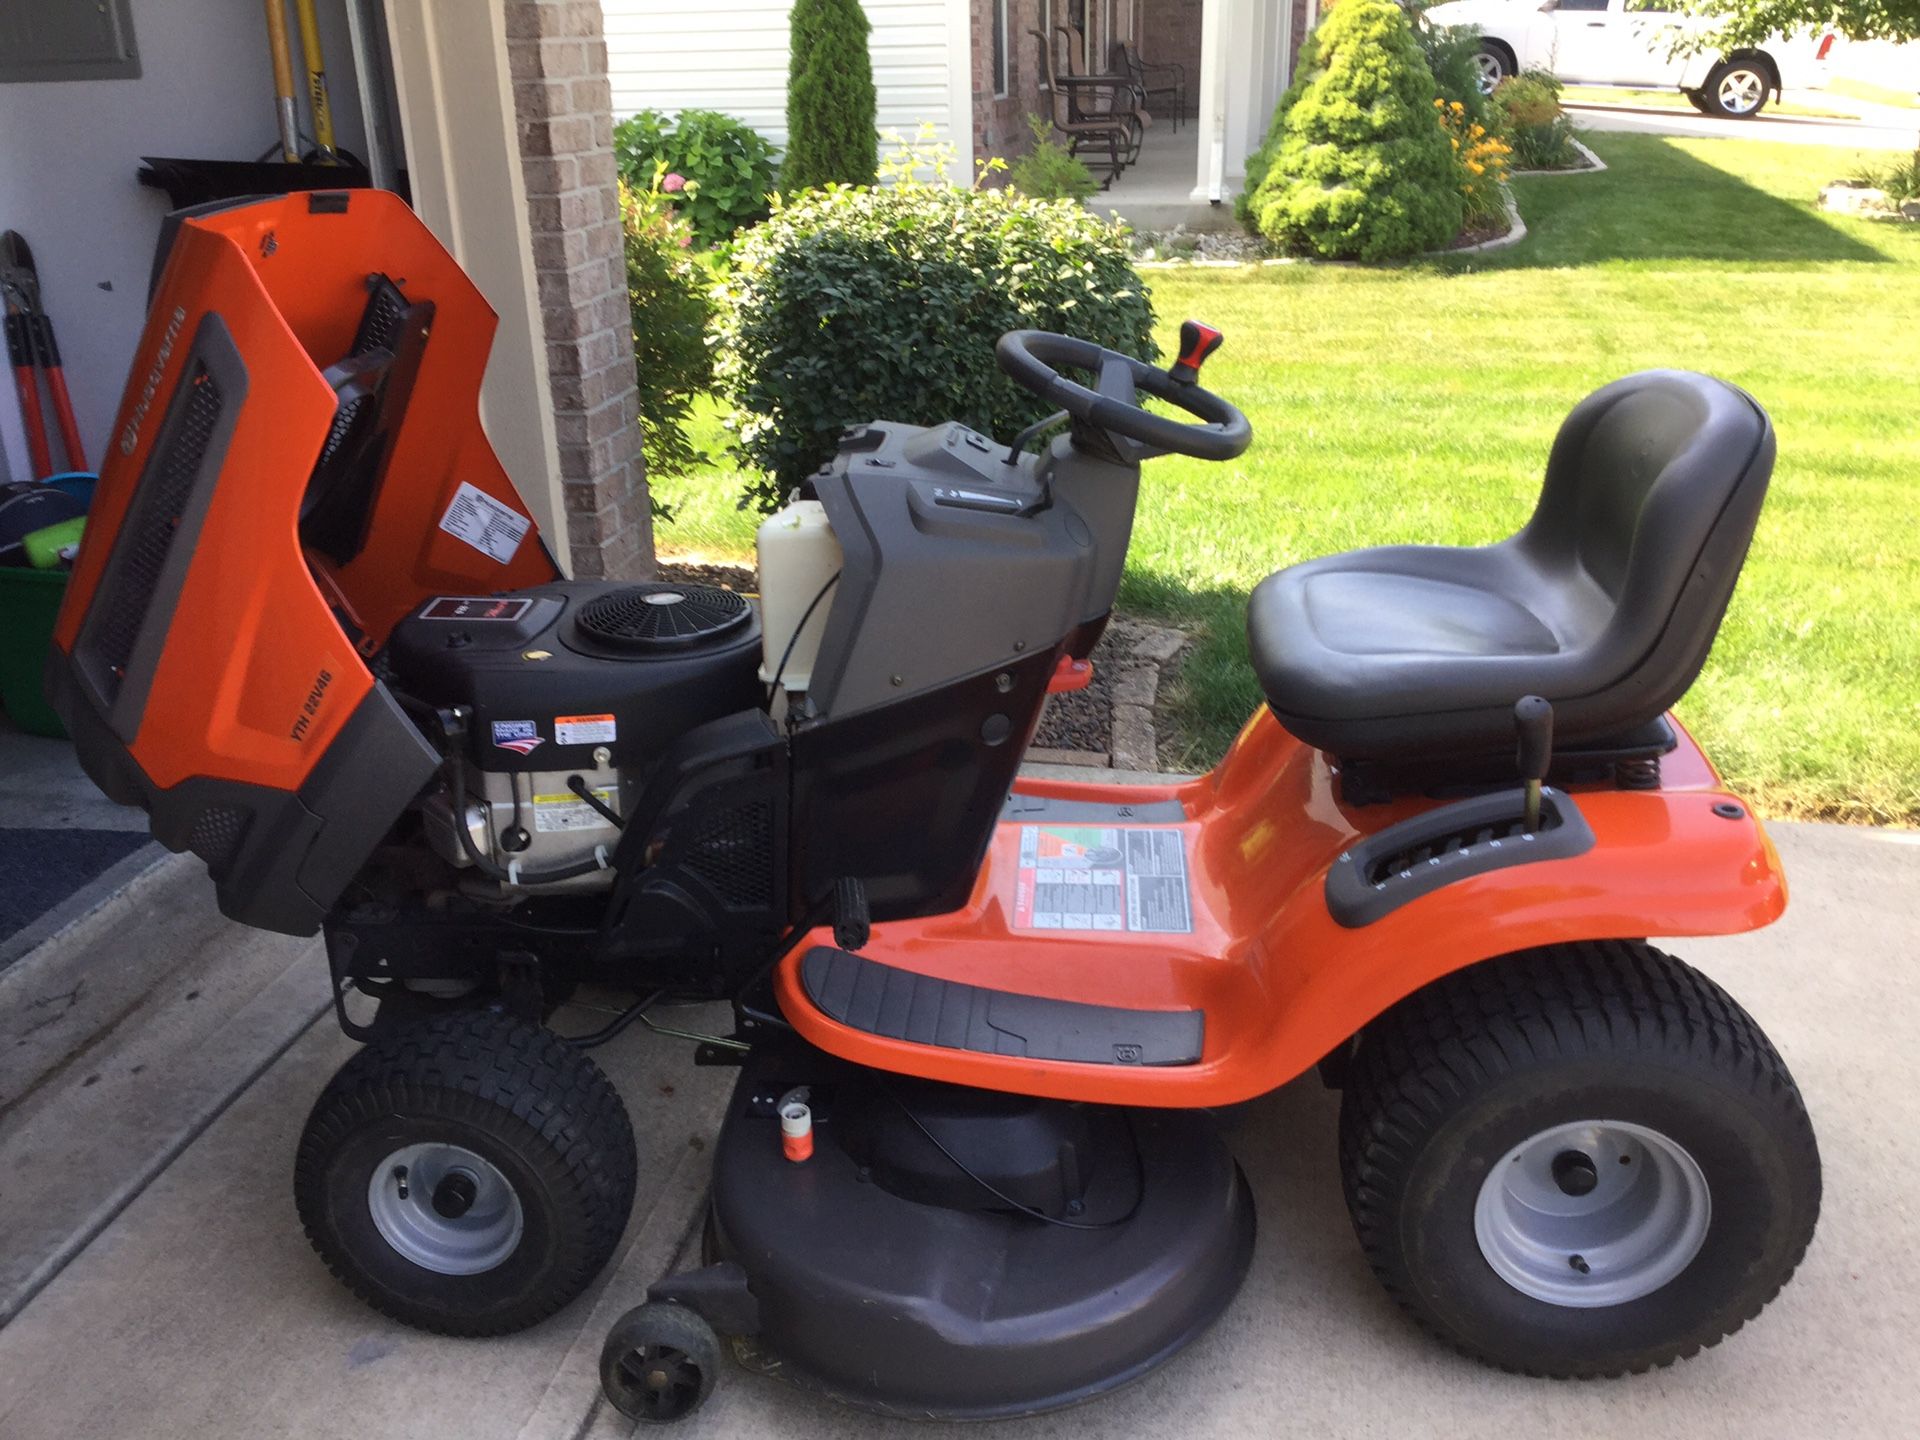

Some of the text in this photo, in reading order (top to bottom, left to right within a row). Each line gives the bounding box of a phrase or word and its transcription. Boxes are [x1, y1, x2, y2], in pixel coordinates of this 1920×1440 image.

[290, 714, 310, 741] YTH
[1400, 869, 1412, 879] 2
[1428, 857, 1440, 866] 3
[1458, 848, 1470, 857] 4
[1489, 839, 1502, 848] 5
[1521, 833, 1535, 842] 6
